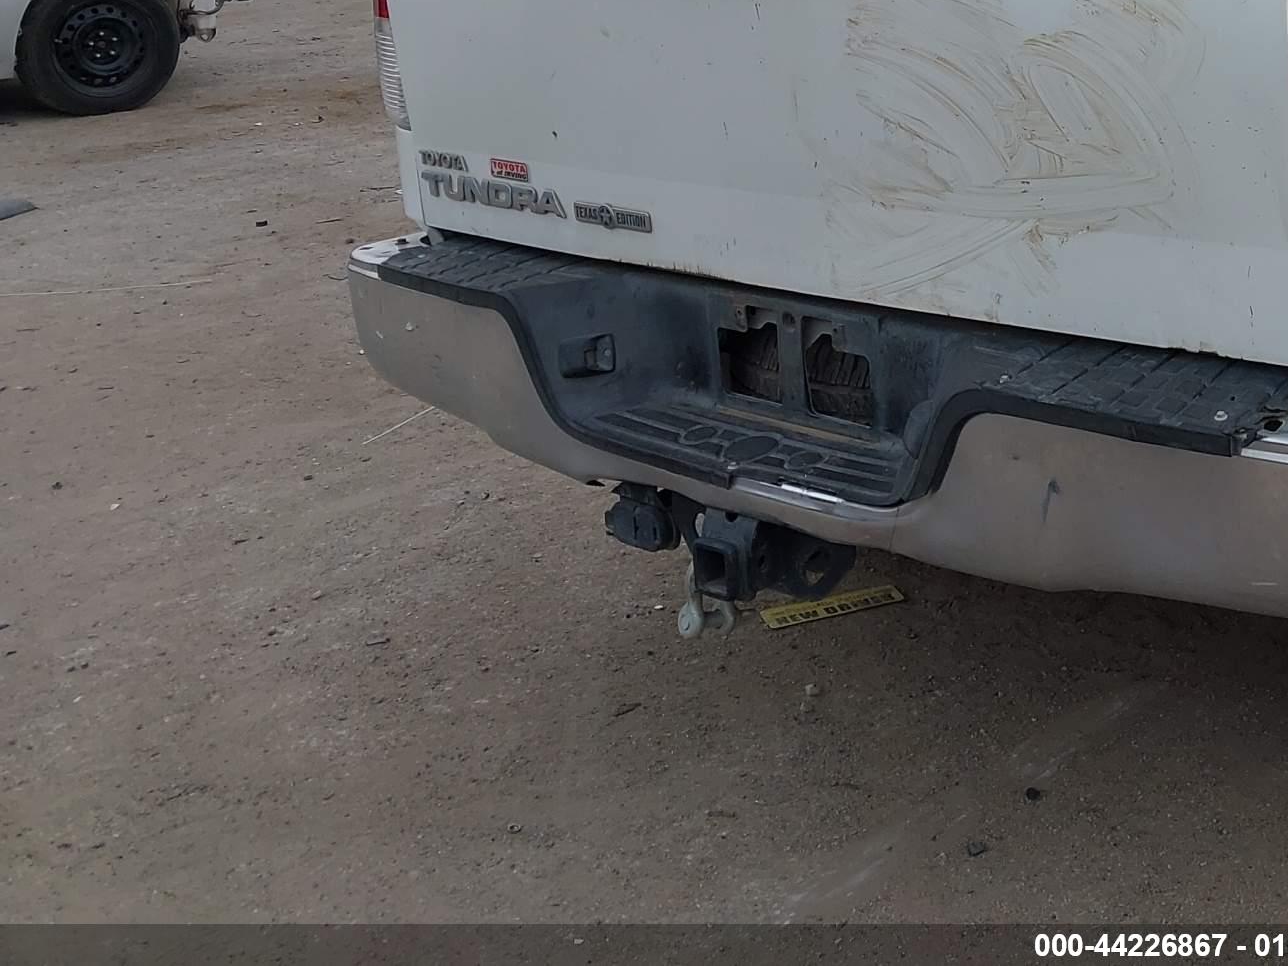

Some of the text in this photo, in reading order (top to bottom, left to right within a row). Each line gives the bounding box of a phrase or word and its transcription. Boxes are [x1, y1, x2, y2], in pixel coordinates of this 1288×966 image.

[418, 149, 469, 173] TOYOTA
[492, 161, 527, 173] TOYOTA
[420, 170, 568, 220] TUNDRA
[575, 205, 648, 229] TEXAS EDITION
